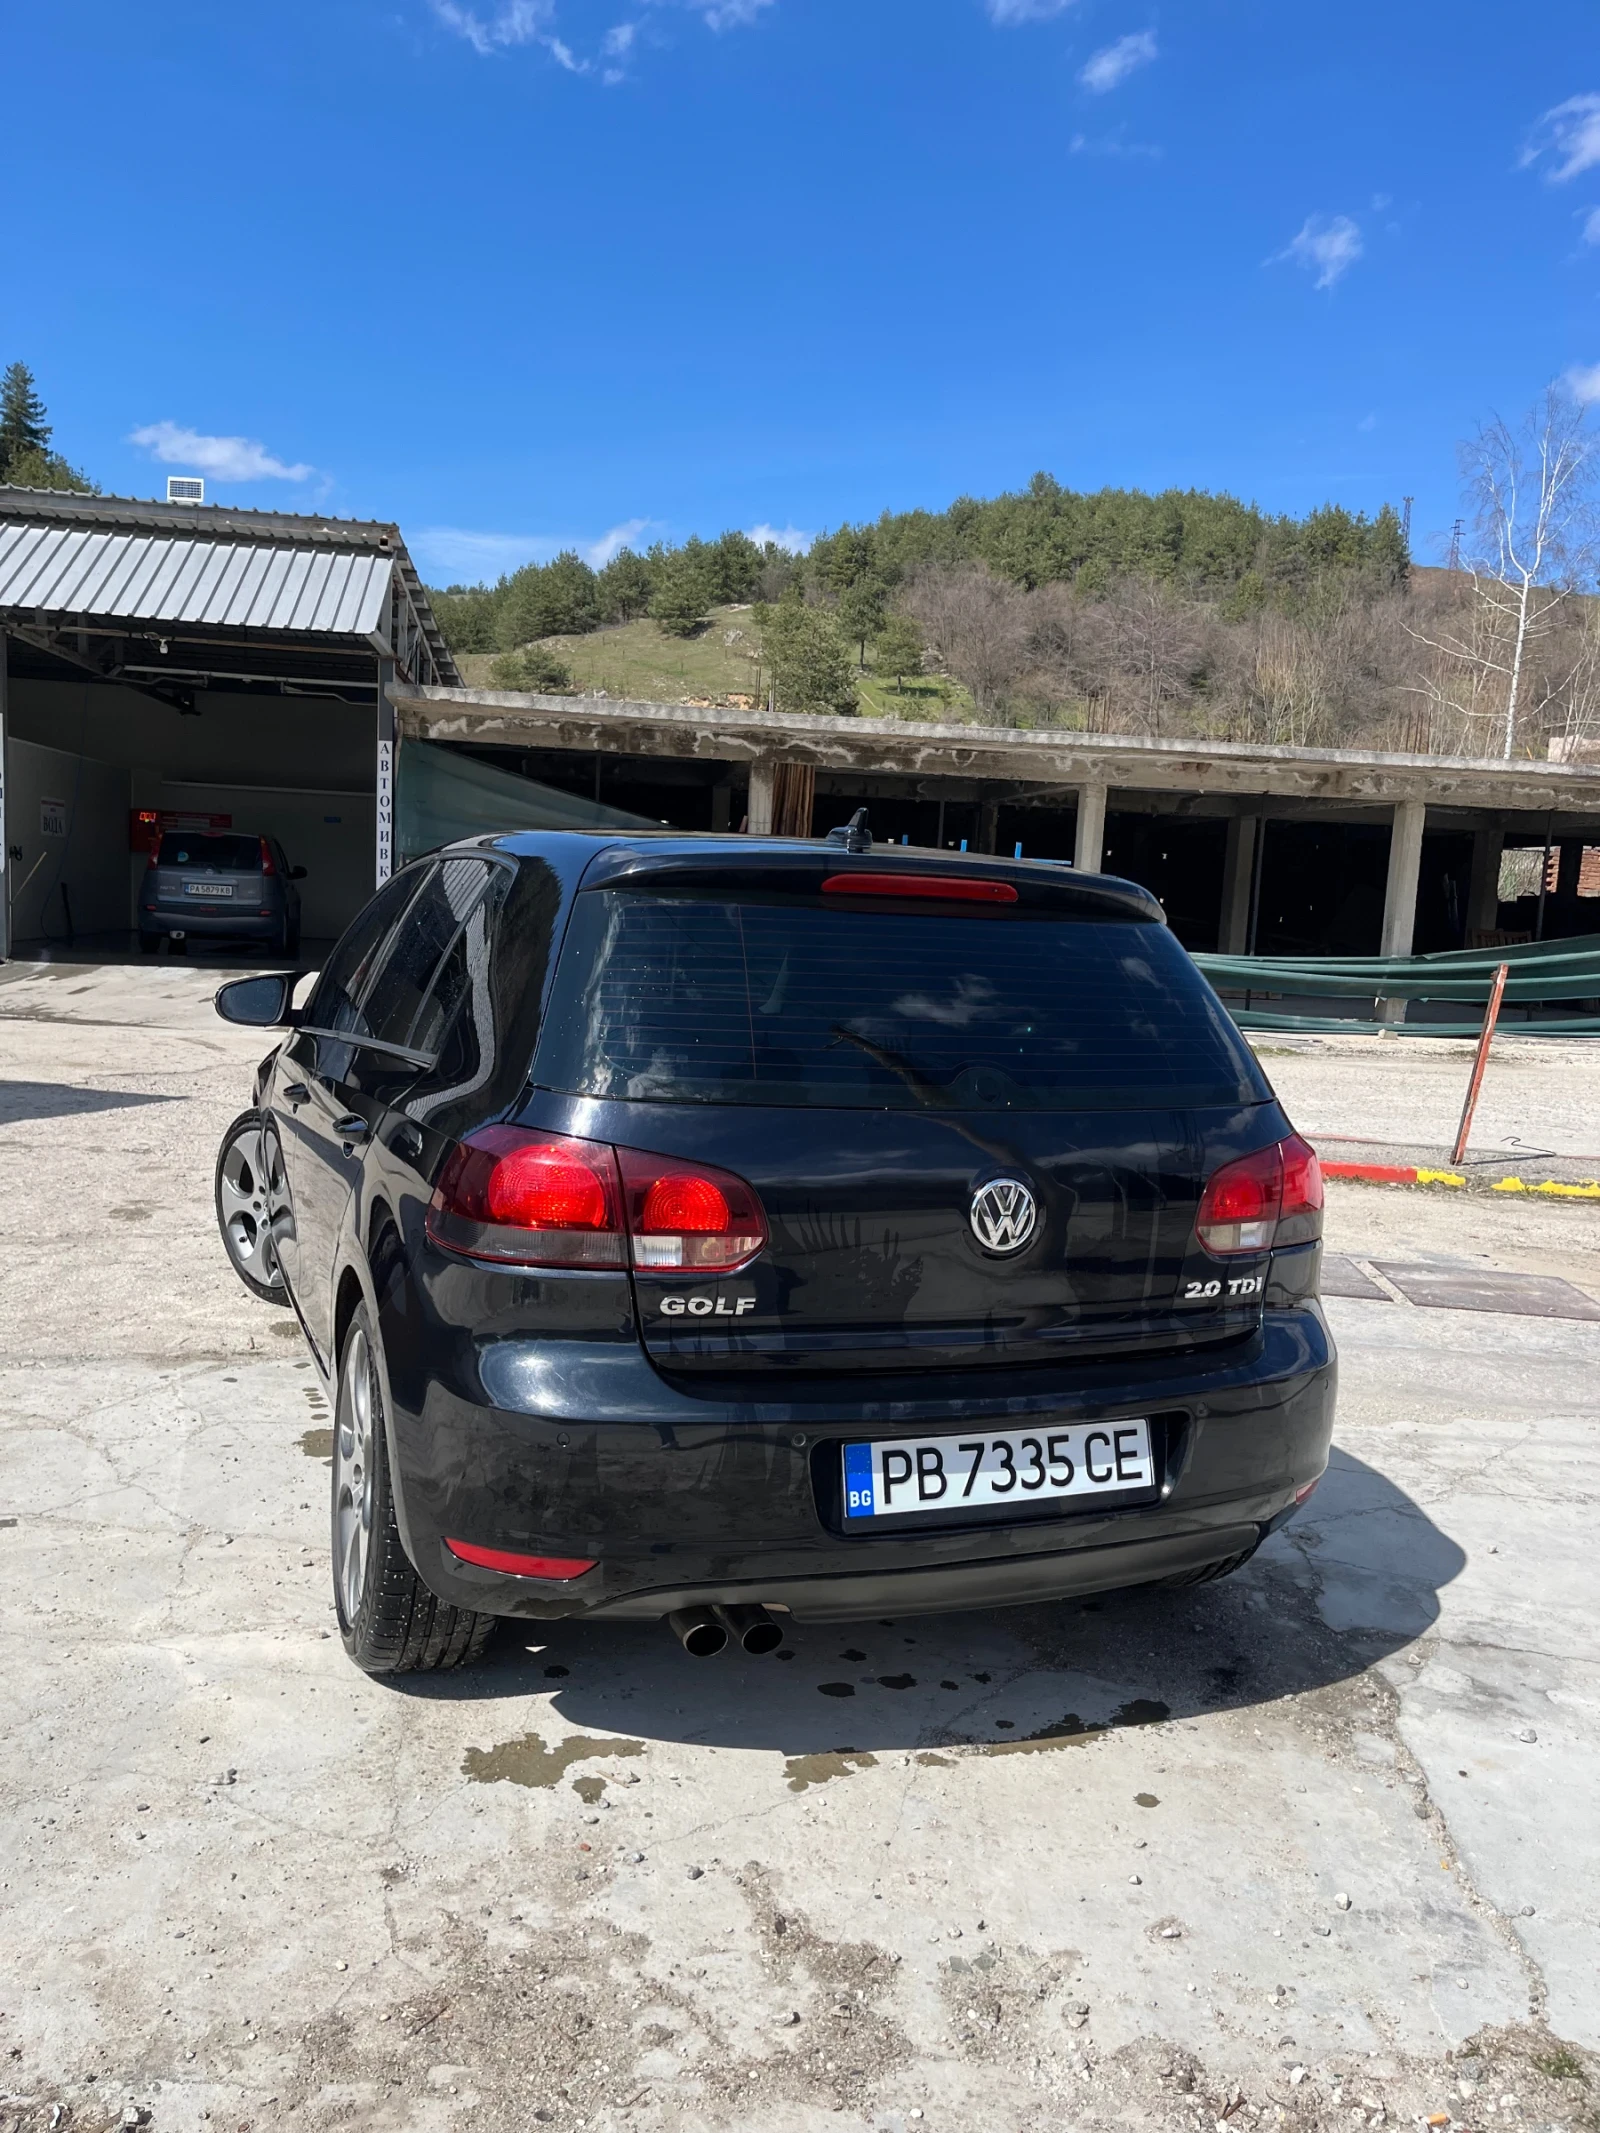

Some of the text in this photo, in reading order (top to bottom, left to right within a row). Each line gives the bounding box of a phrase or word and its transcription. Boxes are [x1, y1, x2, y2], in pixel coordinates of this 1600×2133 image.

[379, 742, 391, 878] АВТОМИВК
[43, 815, 63, 835] ВОДА
[189, 885, 200, 893] PA
[201, 886, 219, 894] 5879
[220, 887, 231, 895] KB
[1227, 1276, 1263, 1296] TDI
[659, 1295, 757, 1316] GOLF
[881, 1428, 1143, 1505] PB 7335 CE
[849, 1491, 872, 1508] BG
